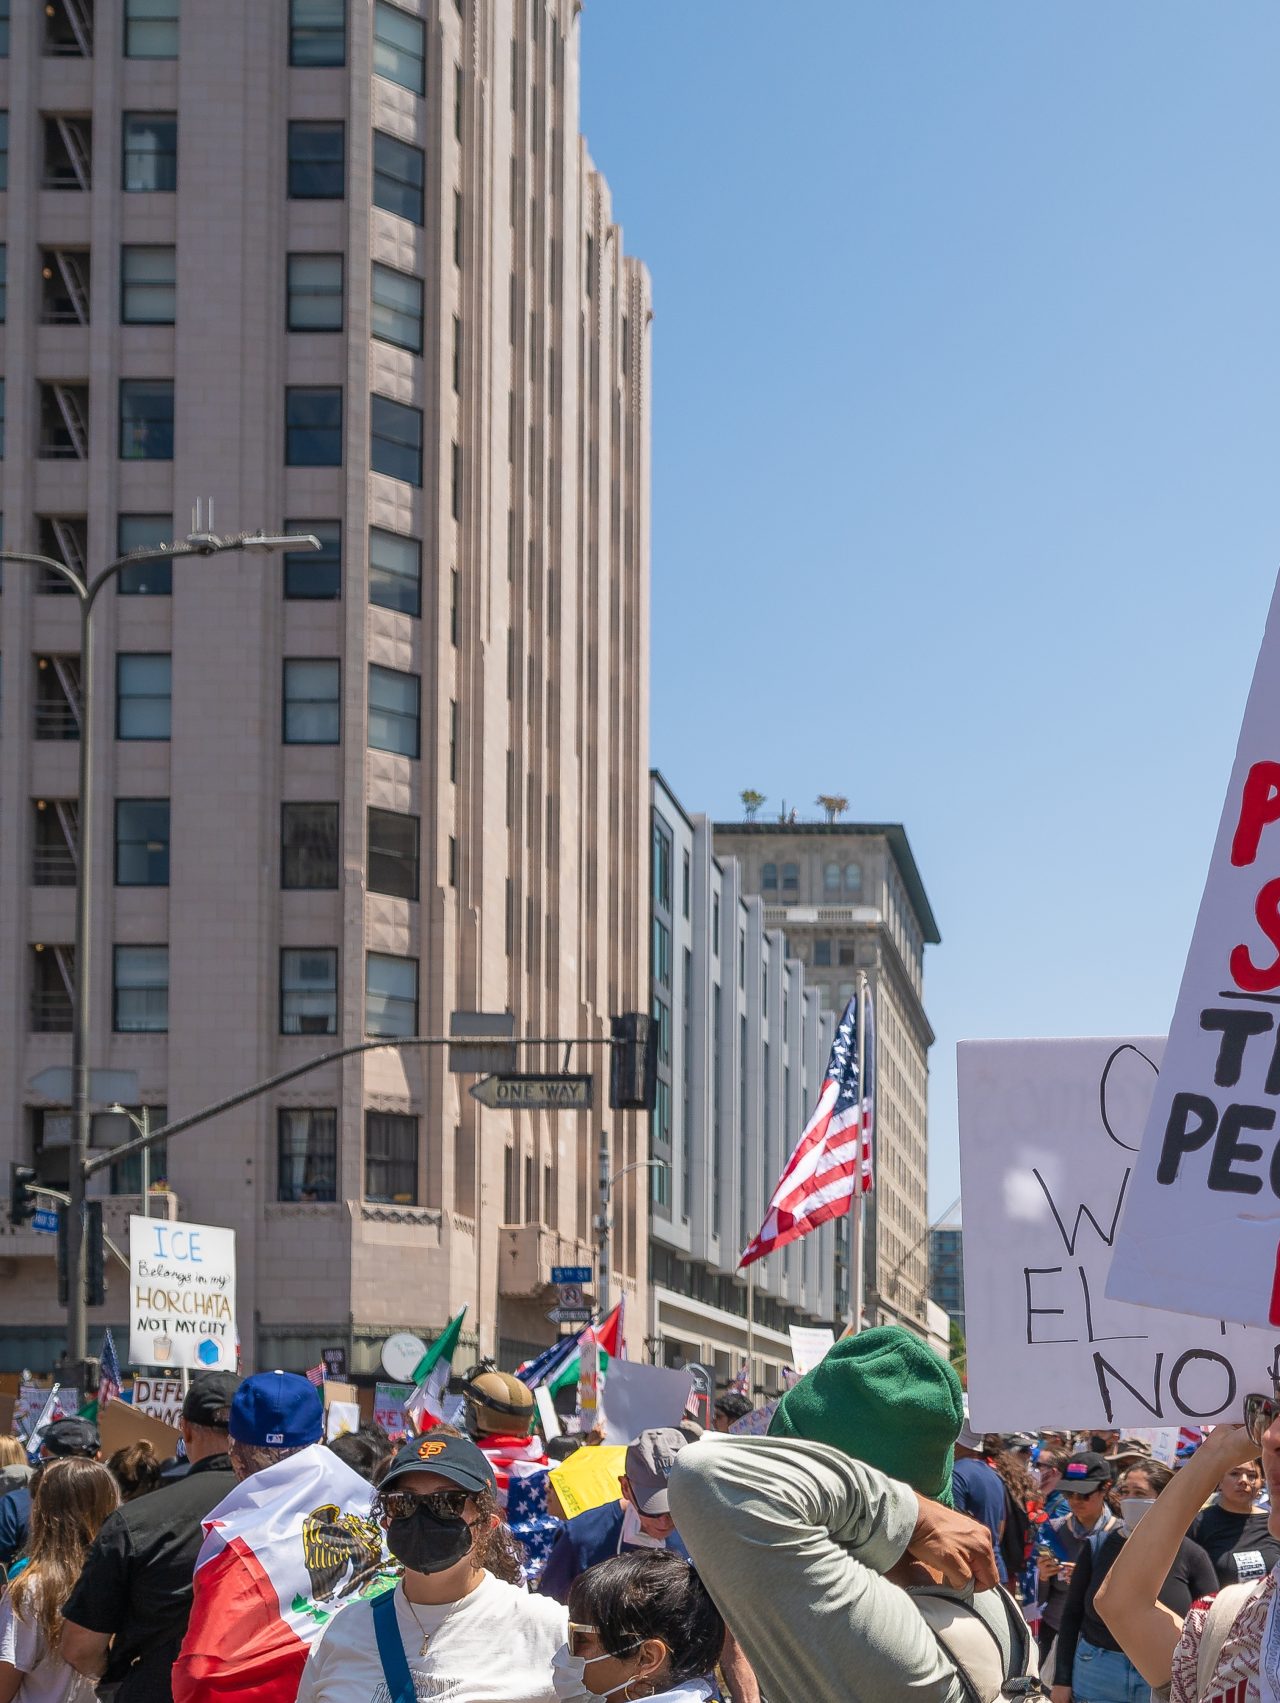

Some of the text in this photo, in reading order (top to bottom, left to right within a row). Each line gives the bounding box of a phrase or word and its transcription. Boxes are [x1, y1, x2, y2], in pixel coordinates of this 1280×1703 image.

[497, 1085, 578, 1099] ONE WAY
[153, 1226, 203, 1262] ICE
[138, 1260, 231, 1289] Belongs in my
[135, 1286, 232, 1321] HORCHATA
[137, 1318, 227, 1335] NOT MY CITY
[135, 1381, 183, 1404] DEFE
[1092, 1348, 1237, 1424] NO
